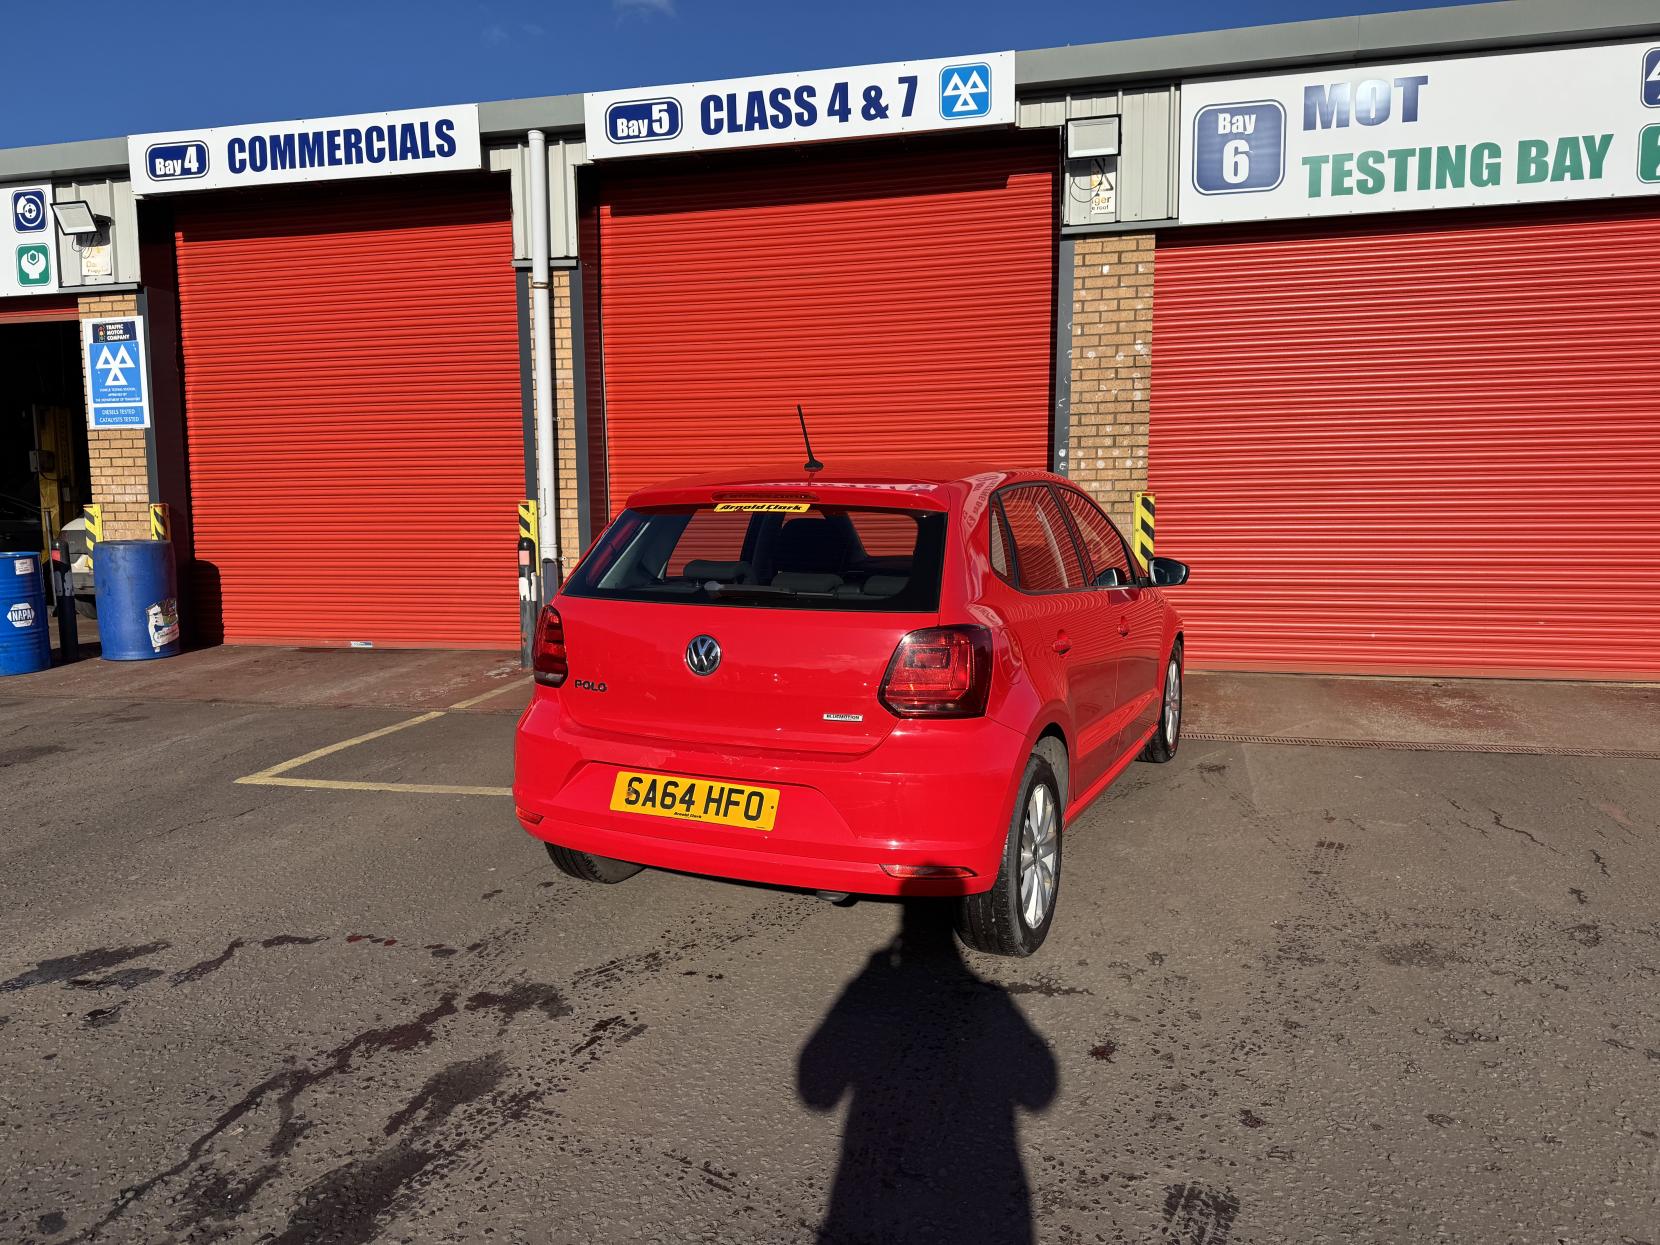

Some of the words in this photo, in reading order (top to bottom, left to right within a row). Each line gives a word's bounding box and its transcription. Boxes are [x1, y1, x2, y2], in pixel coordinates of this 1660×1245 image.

[616, 118, 648, 138] Bay
[651, 104, 670, 134] 5
[700, 85, 818, 136] CLASS
[827, 82, 852, 123] 4
[861, 85, 889, 121] &
[897, 75, 918, 117] 7
[1217, 113, 1256, 135] Bay
[1303, 75, 1428, 131] MOT
[155, 158, 182, 176] Bay
[184, 146, 200, 173] 4
[227, 119, 457, 174] COMMERCIALS
[1222, 139, 1251, 184] 6
[1302, 142, 1502, 198] TESTING
[1516, 133, 1615, 185] BAY
[11, 609, 33, 622] NAPA
[574, 679, 608, 693] POLO
[624, 776, 696, 812] SA64
[703, 785, 764, 821] HFO
